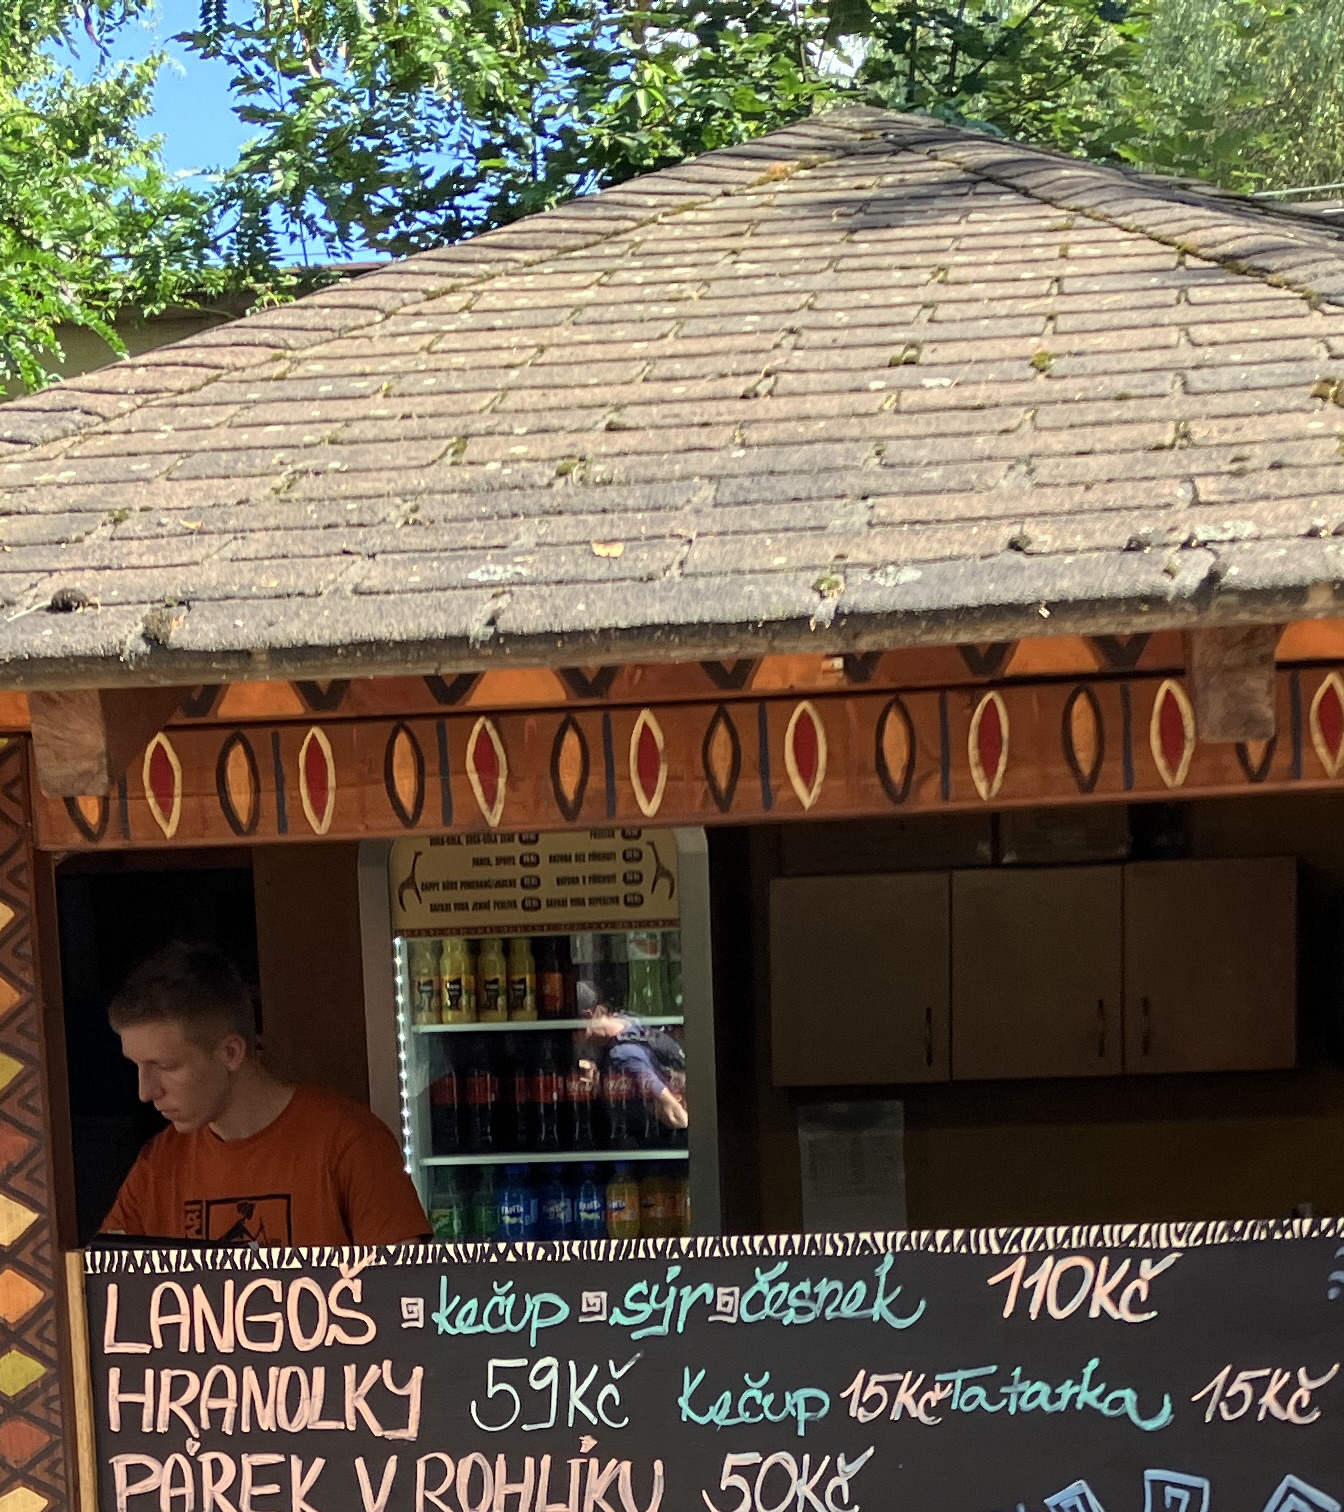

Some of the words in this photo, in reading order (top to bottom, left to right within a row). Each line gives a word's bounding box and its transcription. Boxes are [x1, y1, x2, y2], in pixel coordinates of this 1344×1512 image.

[103, 1250, 378, 1355] LANGOŠ
[432, 1275, 570, 1347] kečup
[609, 1264, 718, 1340] sýr
[739, 1250, 927, 1329] česnek
[987, 1251, 1184, 1324] 110Kč
[108, 1360, 424, 1441] HRANOLKY
[470, 1352, 643, 1431] 59Kč
[839, 1368, 950, 1426] 15Kč
[935, 1357, 1174, 1431] Tatarka
[1191, 1361, 1341, 1426] 15Kč
